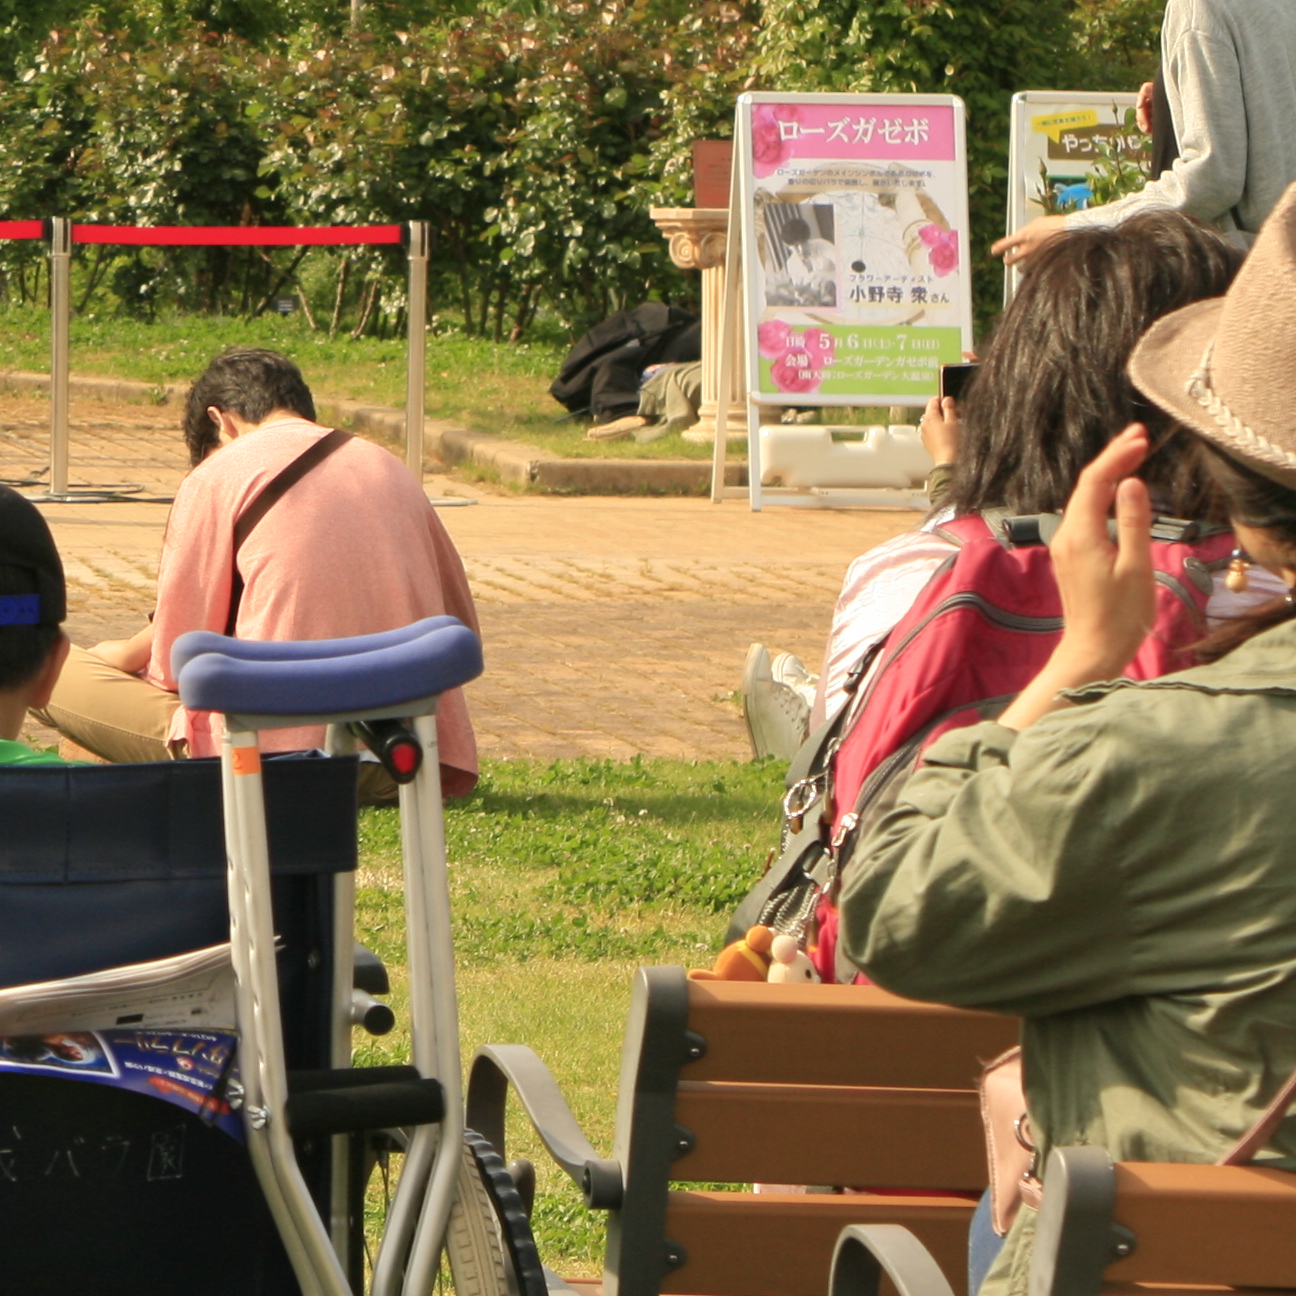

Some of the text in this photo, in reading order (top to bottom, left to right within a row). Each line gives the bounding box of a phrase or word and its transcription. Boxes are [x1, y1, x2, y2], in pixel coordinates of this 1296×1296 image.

[778, 116, 929, 145] ローズガゼボ
[849, 274, 934, 284] フラワーアーティスト
[849, 285, 904, 304] 小野寺
[786, 336, 806, 348] 日時
[785, 354, 808, 367] 会場
